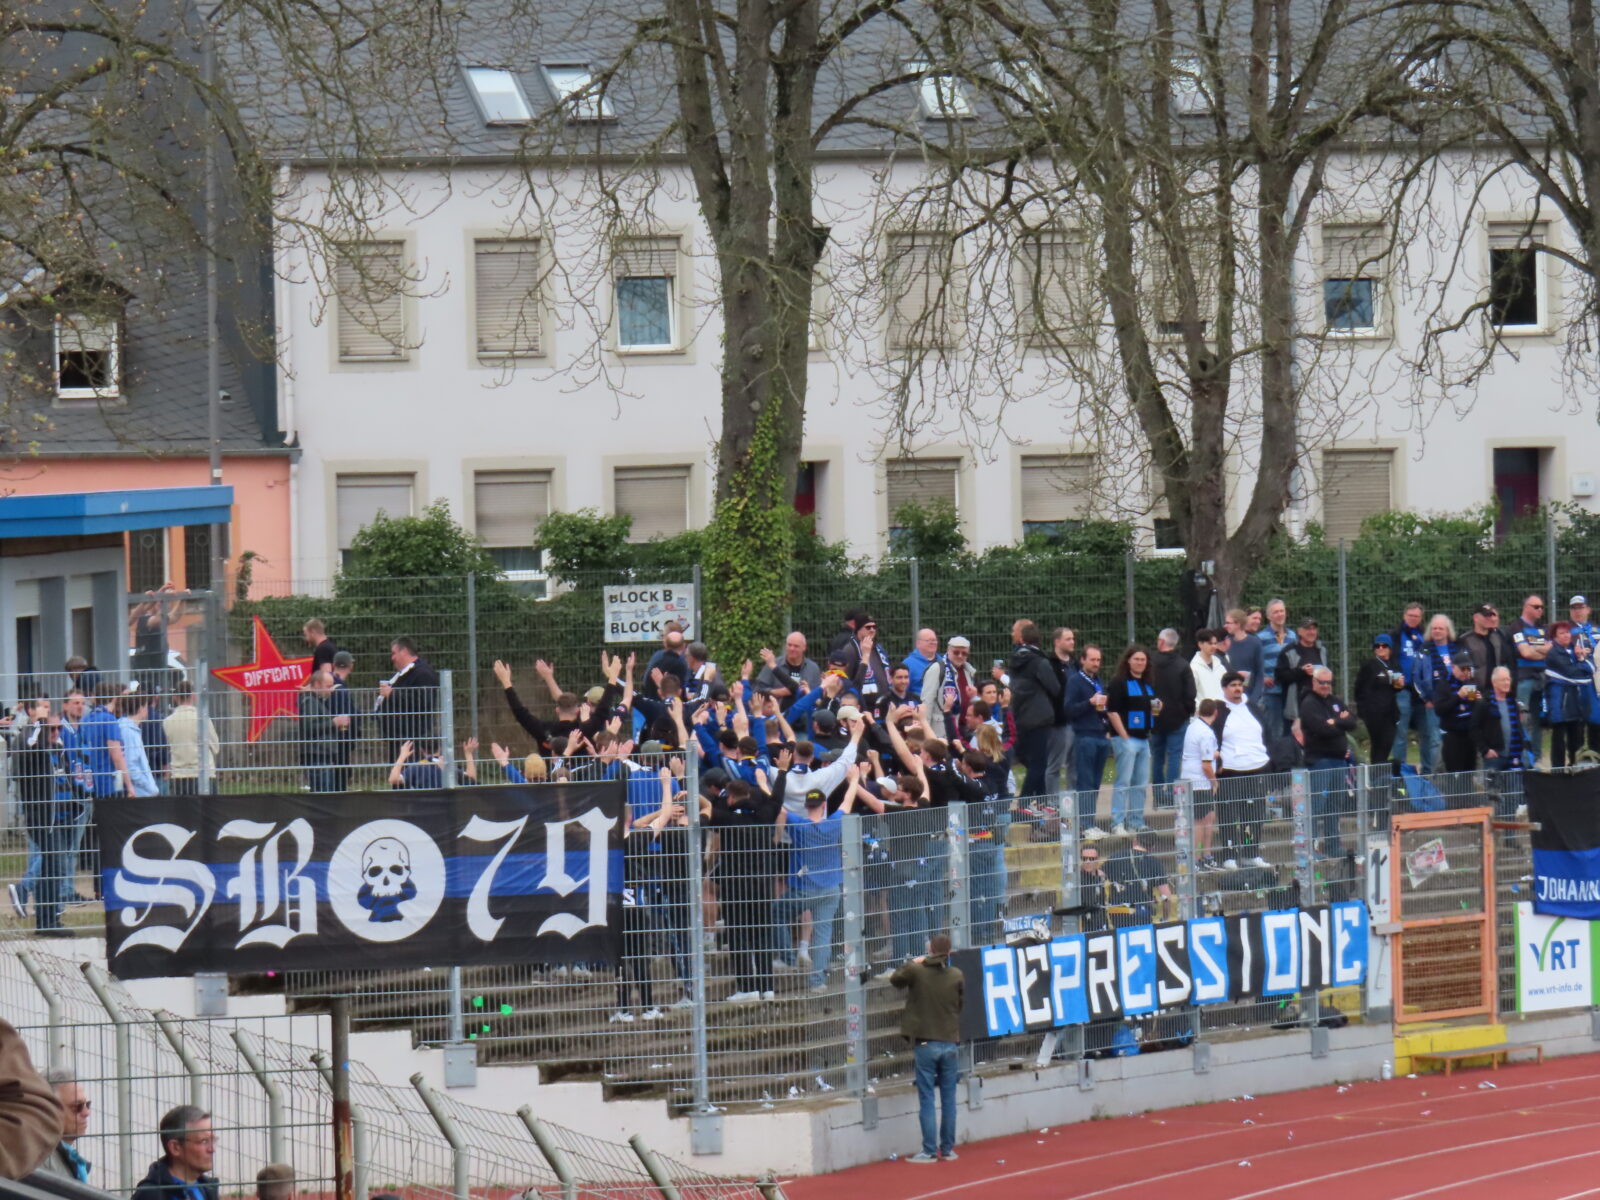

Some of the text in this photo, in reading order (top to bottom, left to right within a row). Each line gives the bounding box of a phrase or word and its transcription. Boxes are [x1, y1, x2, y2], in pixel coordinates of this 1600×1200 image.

[609, 589, 672, 603] BLOCK B
[610, 621, 660, 633] BLOCK
[243, 664, 304, 688] DIFFIDATI
[1529, 927, 1580, 972] VRT
[984, 906, 1363, 1030] REPRESSIONE
[1528, 982, 1583, 996] www.vrt-info.de
